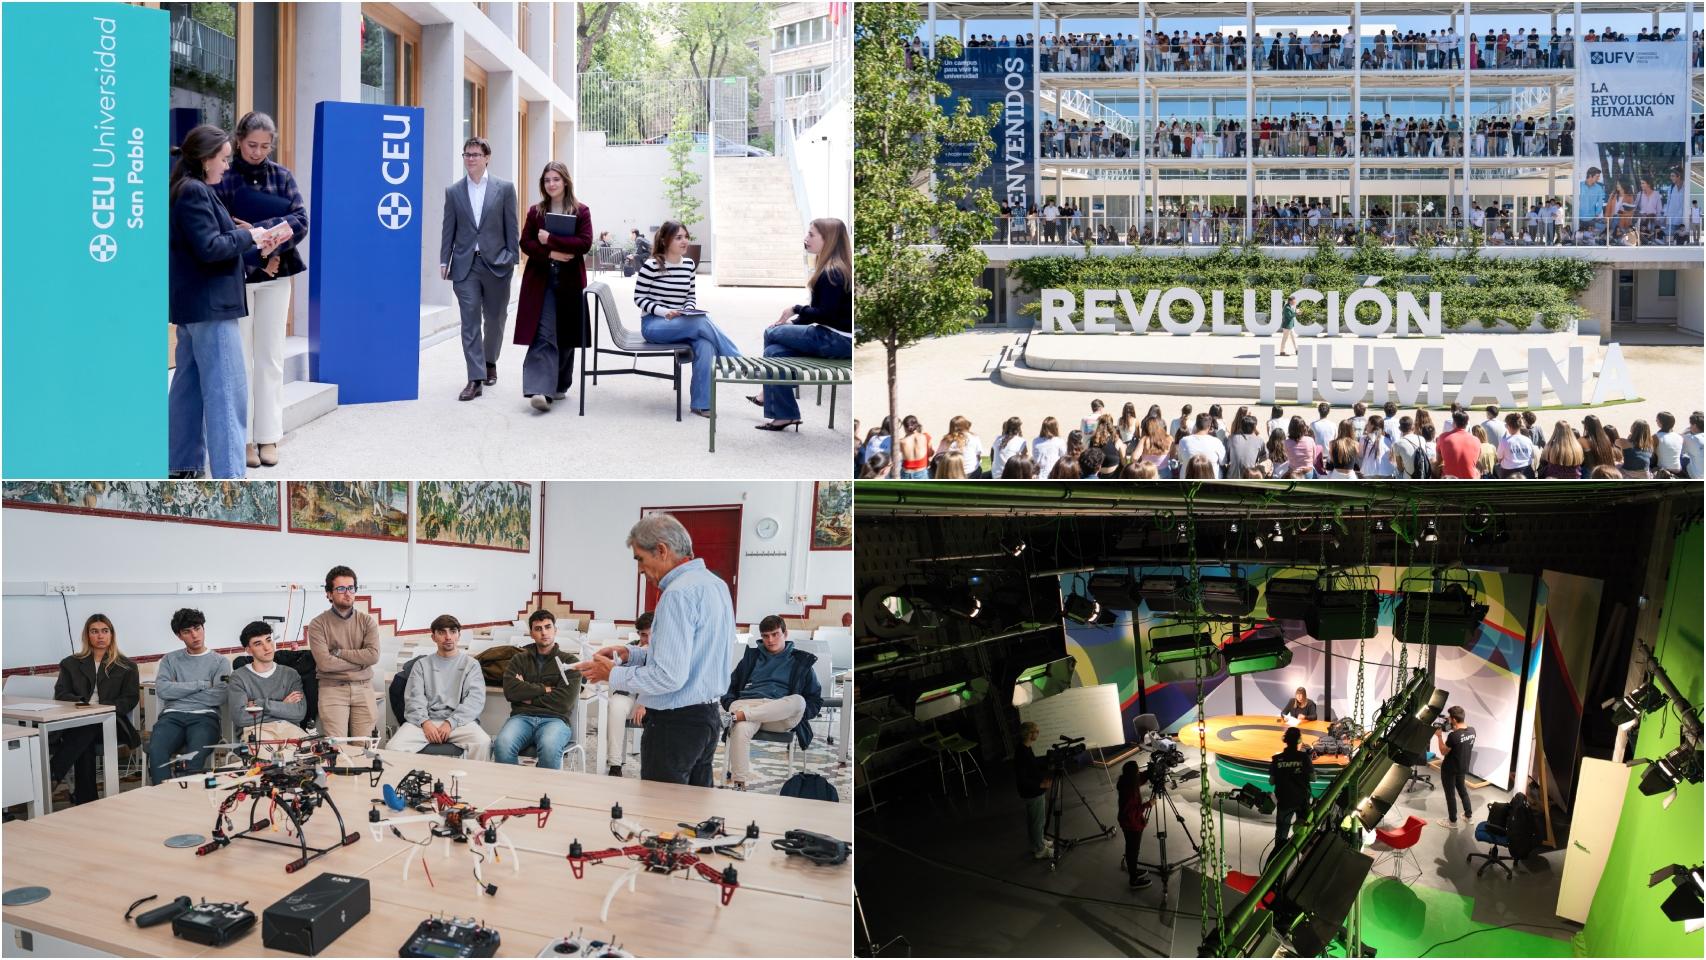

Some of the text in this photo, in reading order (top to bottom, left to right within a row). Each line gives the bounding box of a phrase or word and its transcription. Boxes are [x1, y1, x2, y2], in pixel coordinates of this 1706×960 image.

[1591, 82, 1609, 93] LA
[1604, 51, 1635, 64] UFV
[92, 16, 116, 229] CEU Universidad
[1591, 93, 1675, 106] REVOLUCIÓN
[1591, 106, 1655, 117] HUMANA
[382, 114, 411, 185] CEU
[1004, 57, 1027, 231] ENVENIDOS
[127, 127, 145, 229] San Pablo
[1041, 276, 1442, 337] REVOLUCIÓN
[1259, 342, 1639, 408] HUMANA
